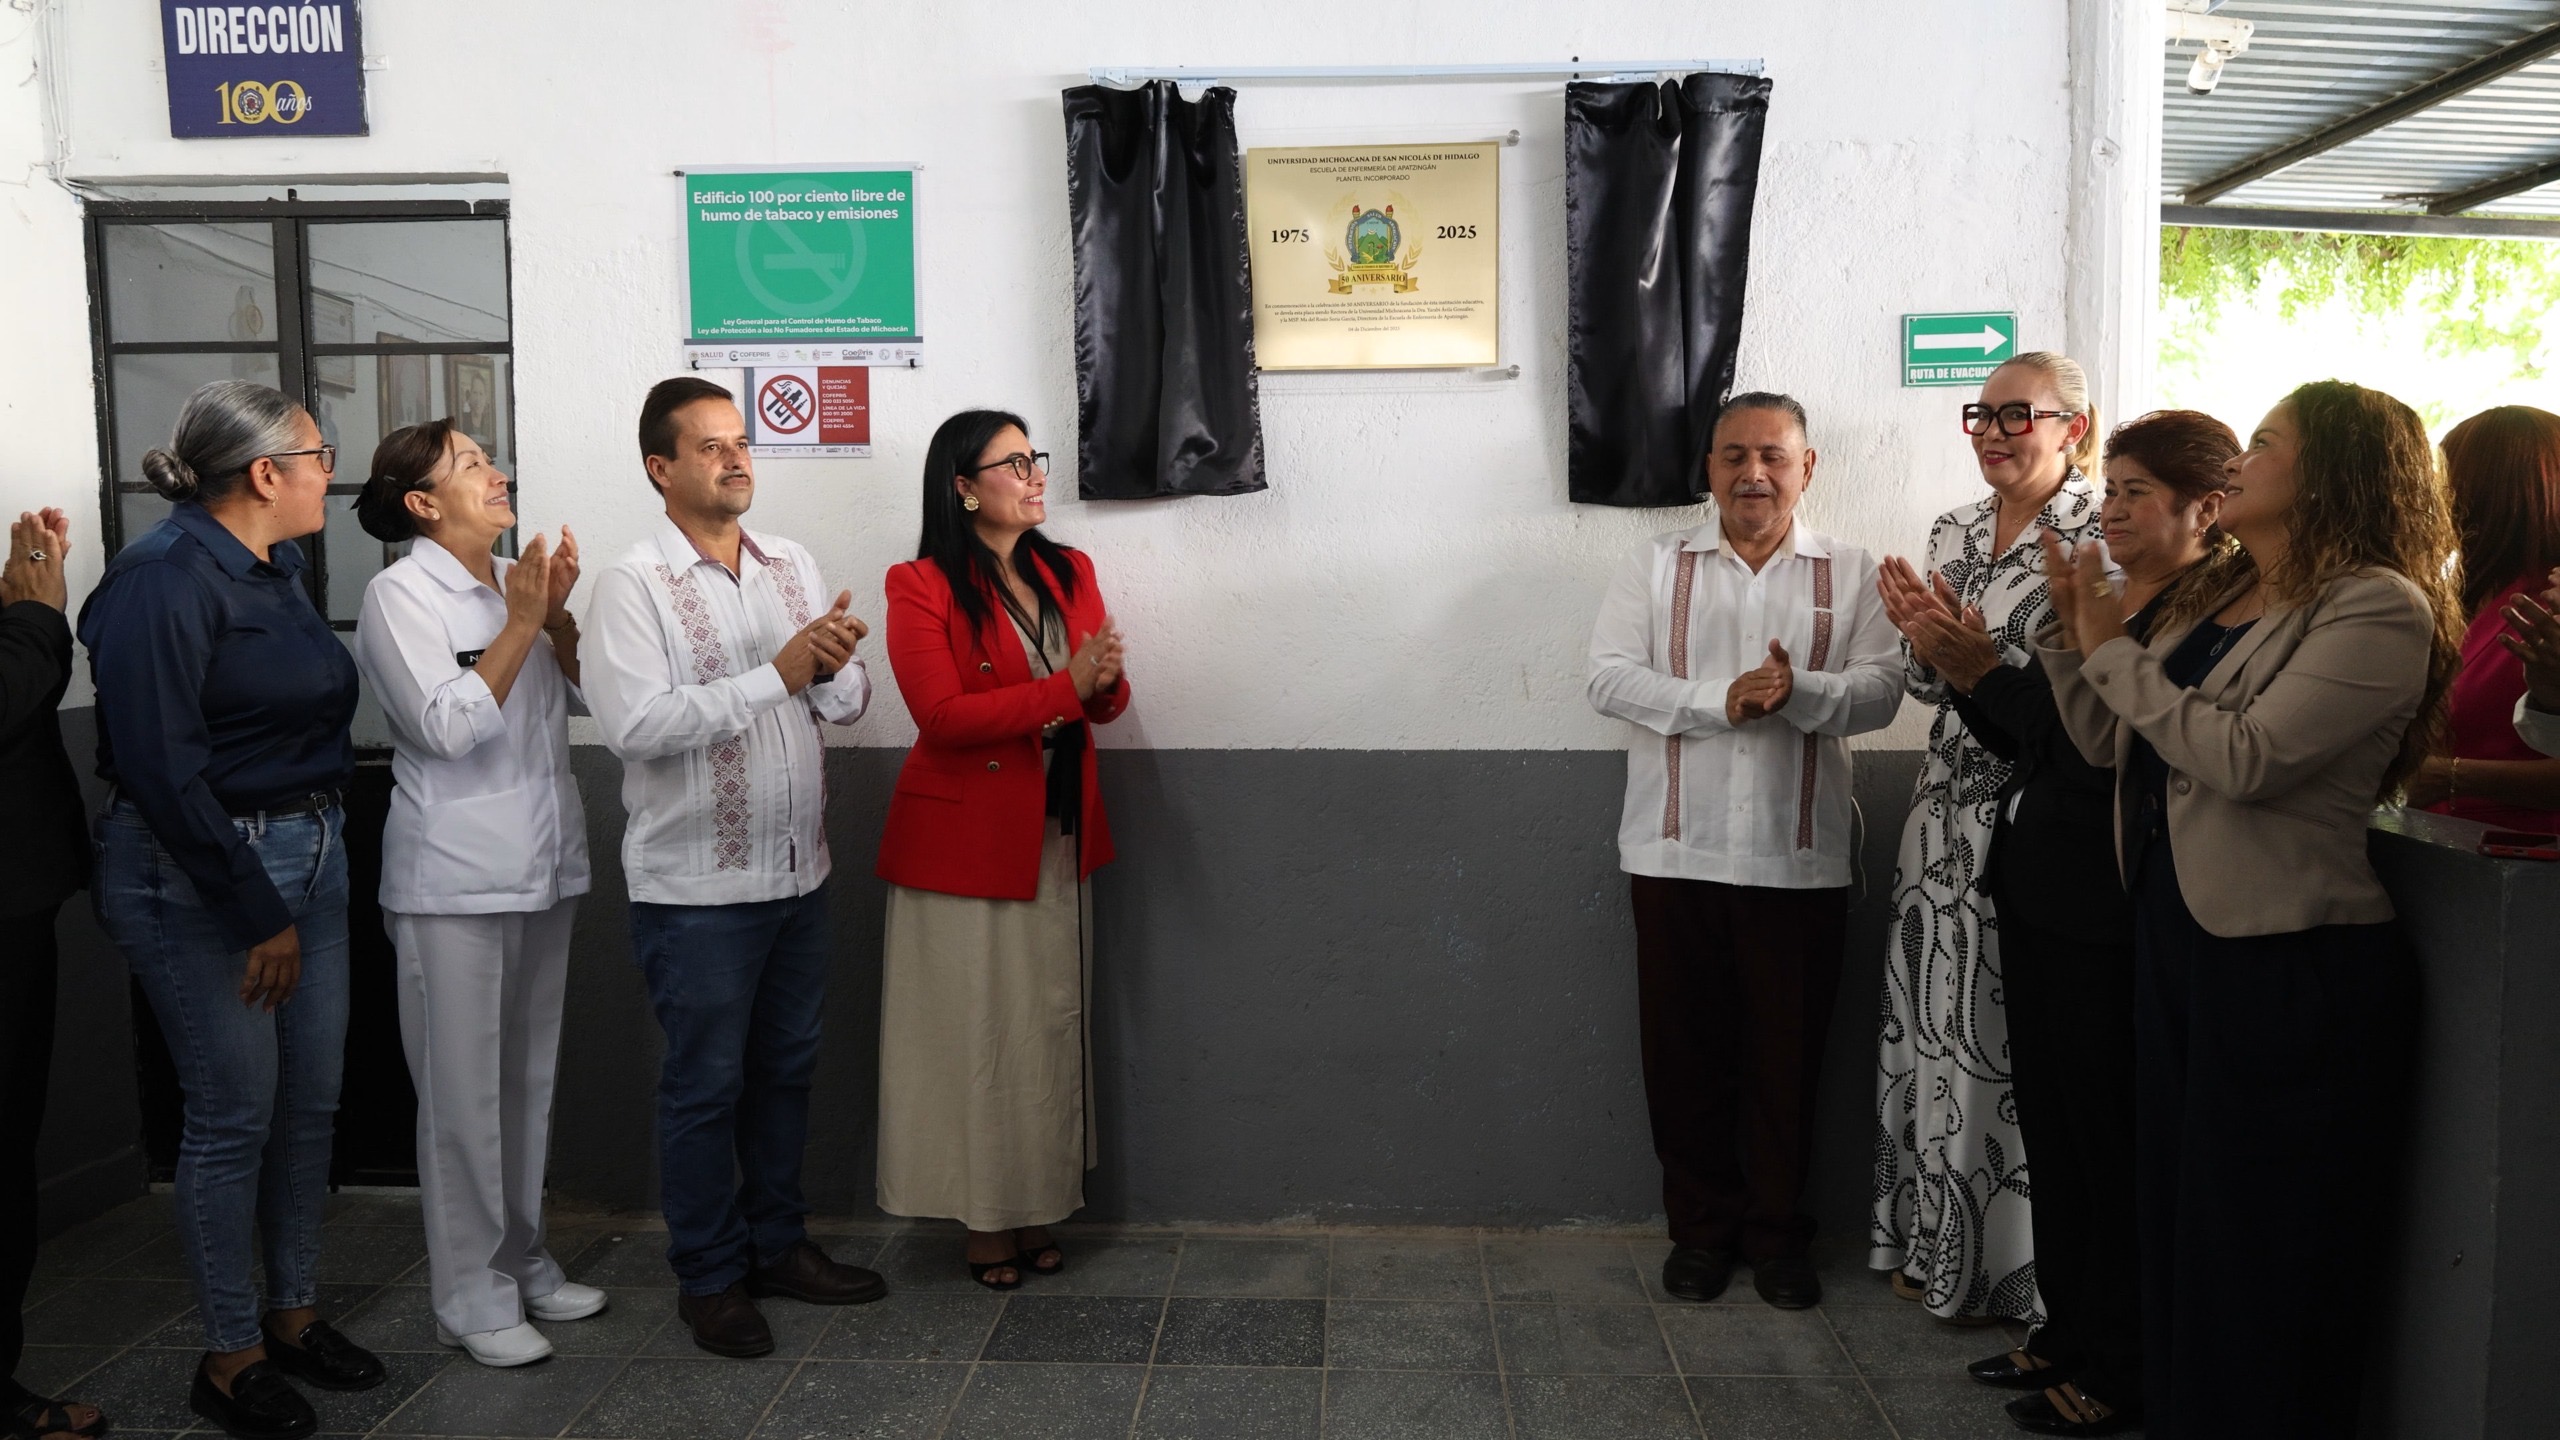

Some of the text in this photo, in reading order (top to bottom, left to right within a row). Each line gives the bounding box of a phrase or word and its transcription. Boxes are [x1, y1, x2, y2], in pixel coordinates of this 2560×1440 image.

[176, 0, 343, 54] DIRECCIÓN
[215, 80, 313, 124] 100 años
[694, 189, 905, 206] Edificio 100 por ciento libre de
[702, 207, 898, 223] humo de tabaco y emisiones
[1271, 229, 1310, 244] 1975
[1436, 225, 1477, 239] 2025
[1352, 274, 1405, 282] ANIVERSARIO
[1910, 368, 1935, 379] RUTA
[1937, 368, 1948, 378] DE
